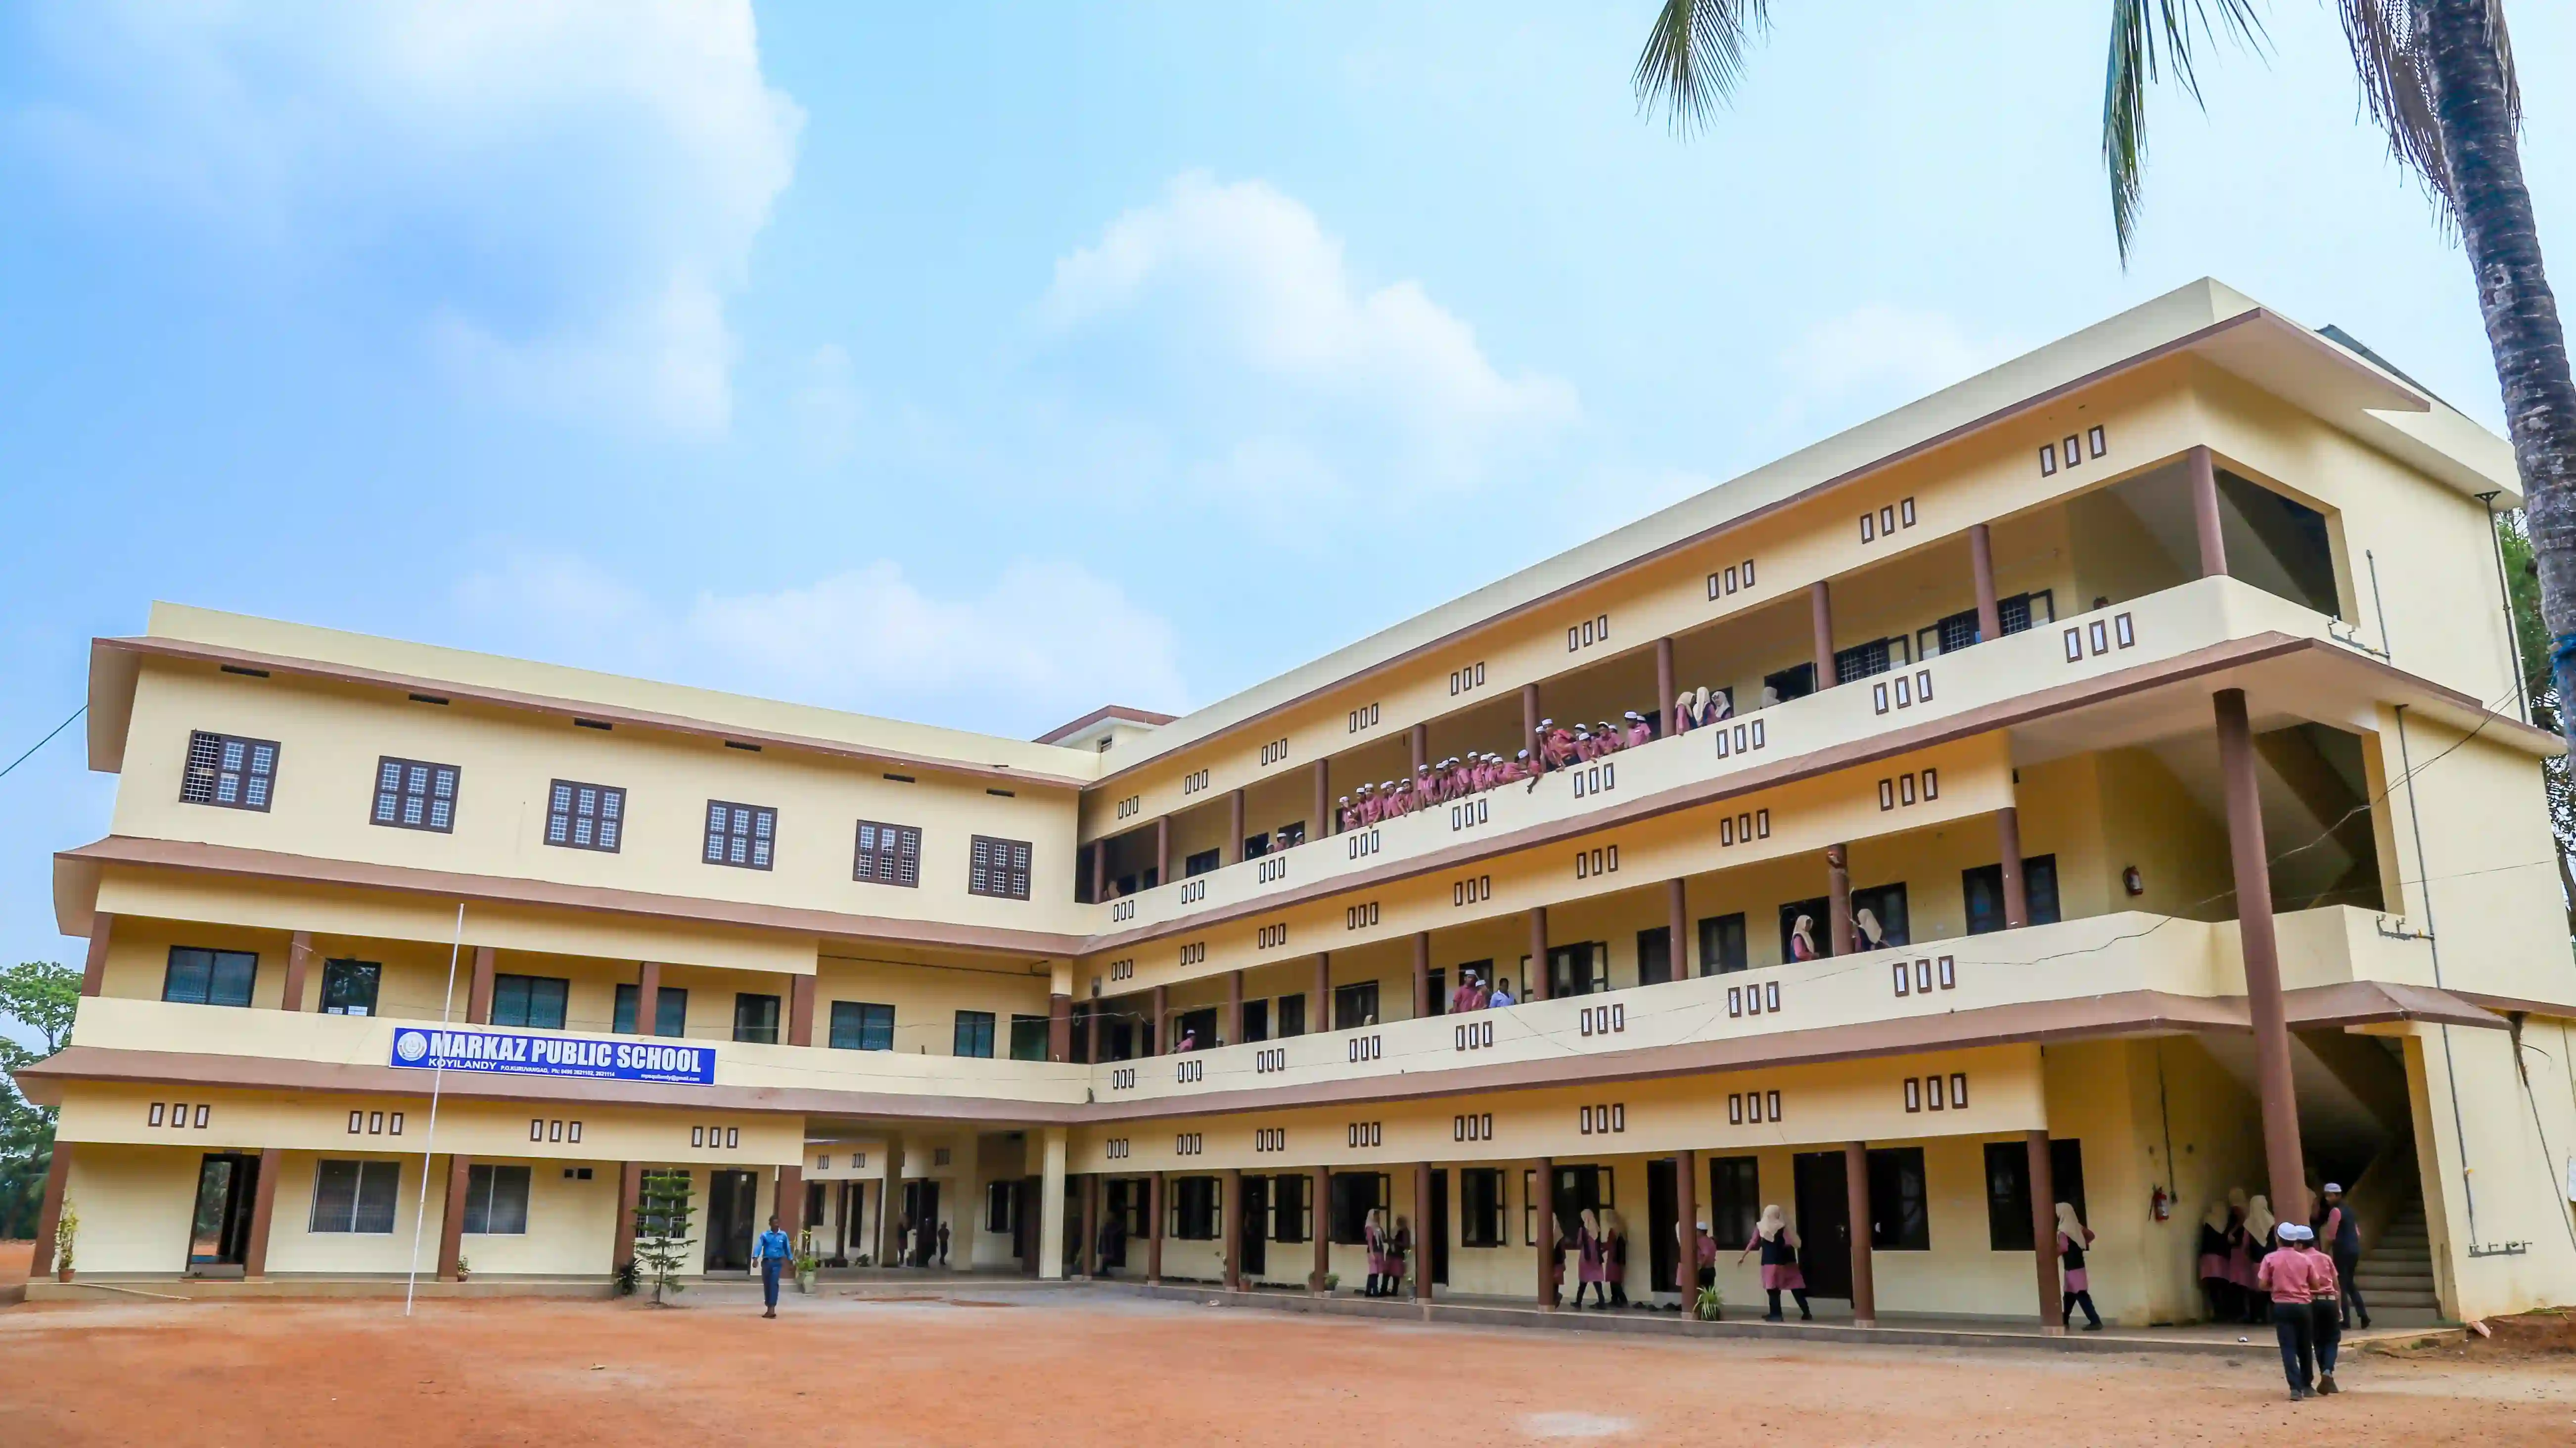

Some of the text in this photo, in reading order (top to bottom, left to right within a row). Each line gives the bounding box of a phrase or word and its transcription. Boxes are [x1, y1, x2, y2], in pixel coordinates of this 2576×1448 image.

[429, 1033, 701, 1072] MARKAZ PUBLIC SCHOOL
[429, 1058, 497, 1069] KOYILANDY
